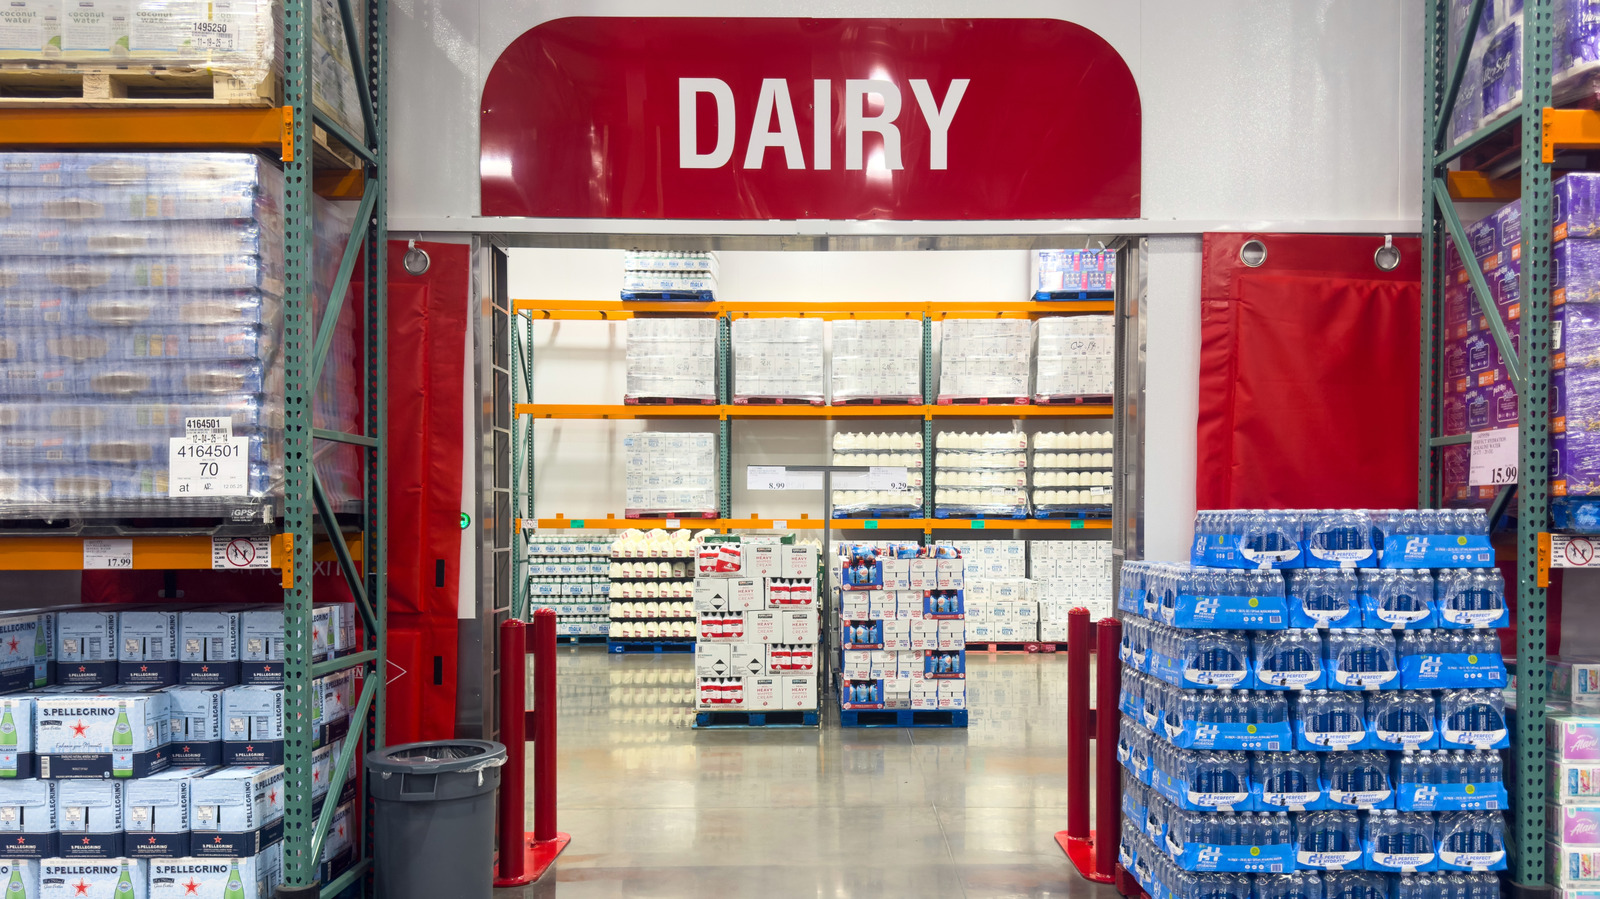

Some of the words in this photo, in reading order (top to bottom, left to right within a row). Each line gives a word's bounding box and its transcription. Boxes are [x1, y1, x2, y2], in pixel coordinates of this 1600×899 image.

[193, 22, 227, 33] 1495250
[678, 78, 970, 170] DAIRY
[187, 420, 220, 428] 4164501
[178, 445, 238, 457] 4164501
[200, 462, 218, 476] 70
[1491, 466, 1517, 483] 15.99
[179, 483, 189, 492] at
[108, 558, 131, 567] 17.99
[0, 622, 36, 634] ELLEGRINO
[43, 708, 115, 716] S.PELLEGRINO
[255, 773, 284, 791] S.PELLEGRIN
[46, 866, 118, 874] S.PELLEGRINO
[156, 865, 228, 874] S.PELLEGRINO
